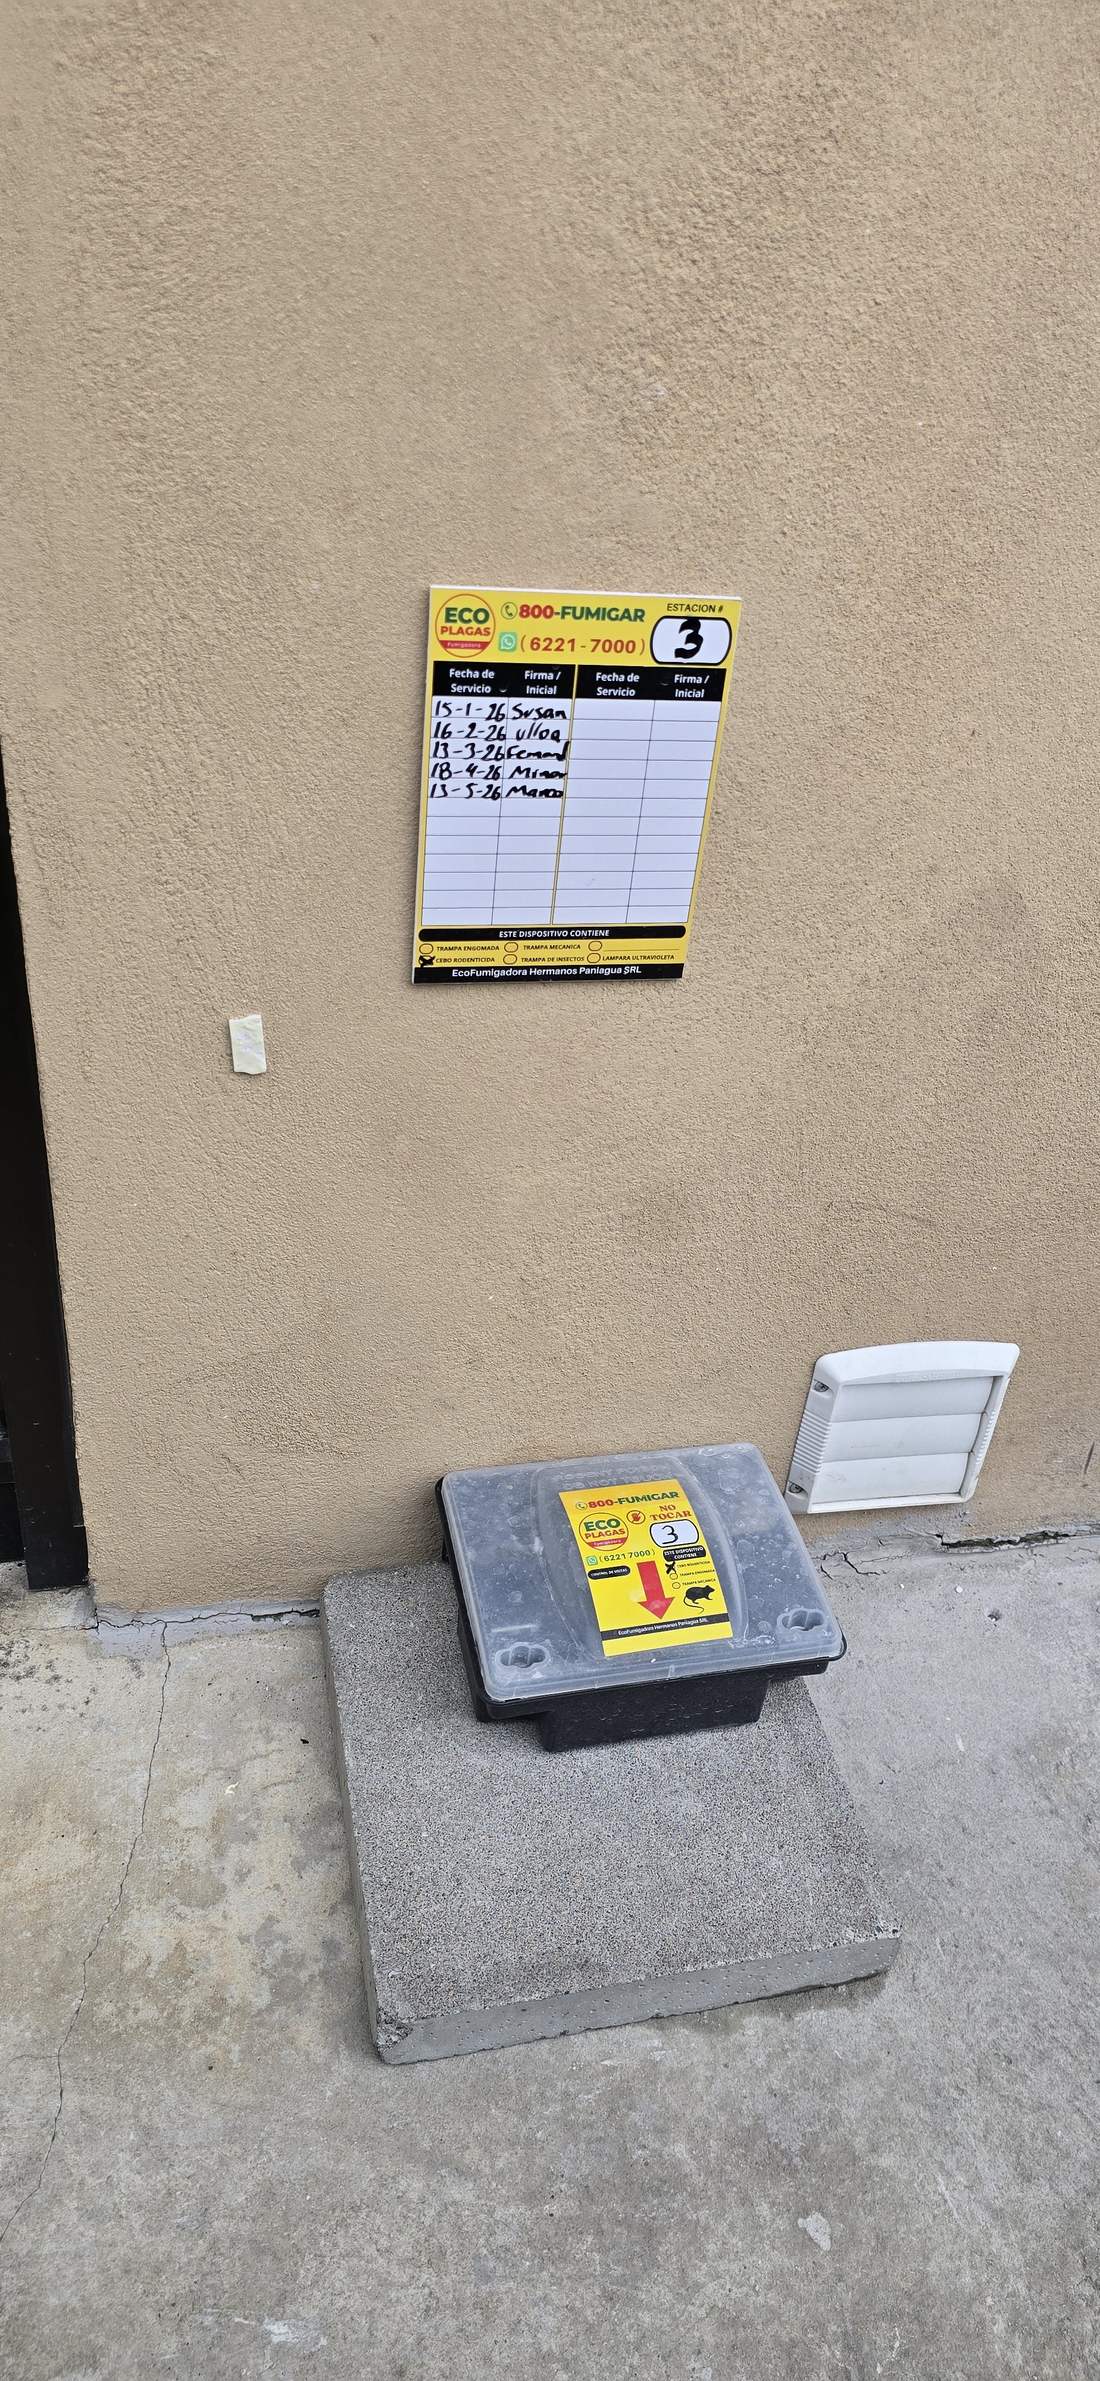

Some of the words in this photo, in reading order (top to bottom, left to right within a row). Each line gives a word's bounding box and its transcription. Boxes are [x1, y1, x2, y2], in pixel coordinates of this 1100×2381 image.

[519, 604, 645, 622] 800-FUMIGAR
[666, 603, 716, 613] ESTACION
[718, 605, 724, 613] #
[445, 607, 490, 624] ECO
[440, 626, 491, 636] PLAGAS
[674, 618, 704, 659] 3
[449, 668, 479, 678] Fecha
[481, 669, 495, 679] de
[524, 670, 553, 681] Firma
[596, 672, 625, 682] Fecha
[627, 673, 640, 683] de
[674, 674, 702, 684] Firma
[451, 684, 492, 694] Servicio
[526, 685, 557, 695] Inicial
[596, 687, 636, 697] Servicio
[675, 689, 705, 698] Inicial
[512, 703, 567, 720] Susan
[499, 930, 517, 938] ESTE
[519, 930, 568, 938] DISPOSITIVO
[570, 929, 610, 937] CONTIENE
[452, 968, 528, 978] EcoFumigadora
[529, 967, 578, 976] Hermanos
[579, 967, 623, 976] Paniagua
[623, 966, 642, 975] SRL
[587, 1491, 680, 1509] 800-FUMIGAR
[659, 1504, 676, 1512] NO
[650, 1510, 692, 1521] TOCAR
[583, 1518, 621, 1531] ECO
[584, 1528, 626, 1540] PLAGAS
[661, 1525, 679, 1545] 3
